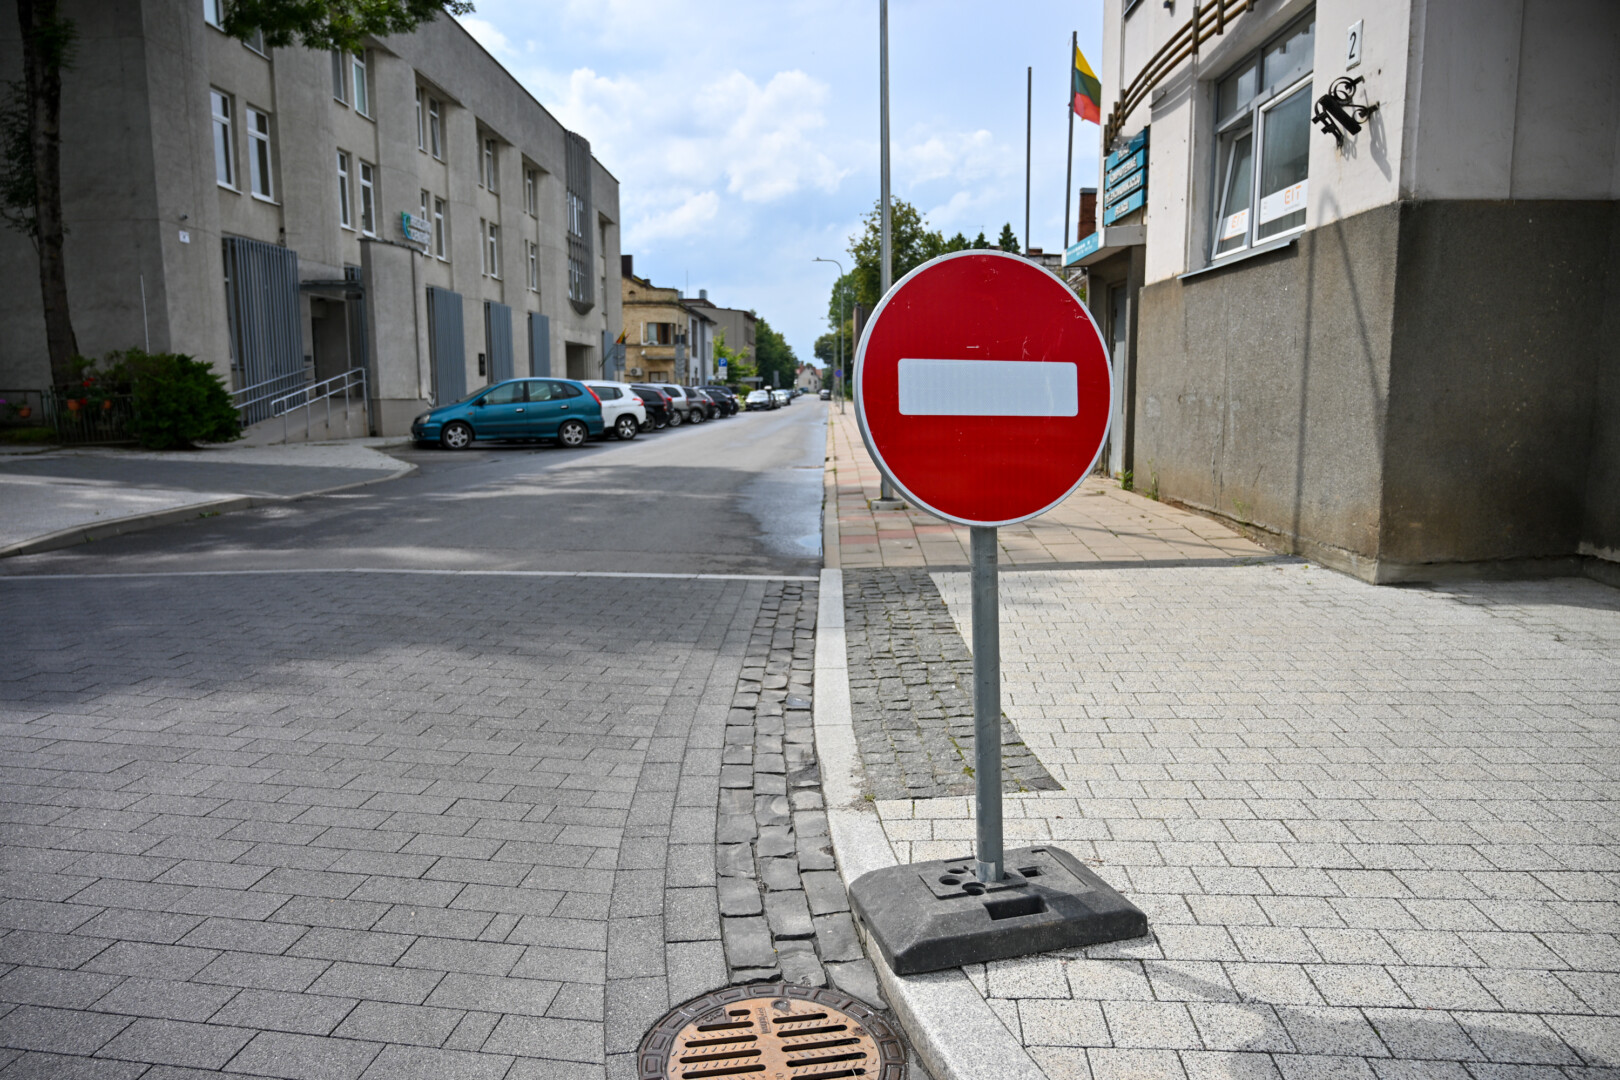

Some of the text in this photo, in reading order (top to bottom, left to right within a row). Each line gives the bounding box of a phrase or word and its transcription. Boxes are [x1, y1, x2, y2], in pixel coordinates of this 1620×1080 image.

[1348, 31, 1357, 59] 2
[1284, 185, 1302, 205] EIT
[1231, 212, 1247, 229] EIT
